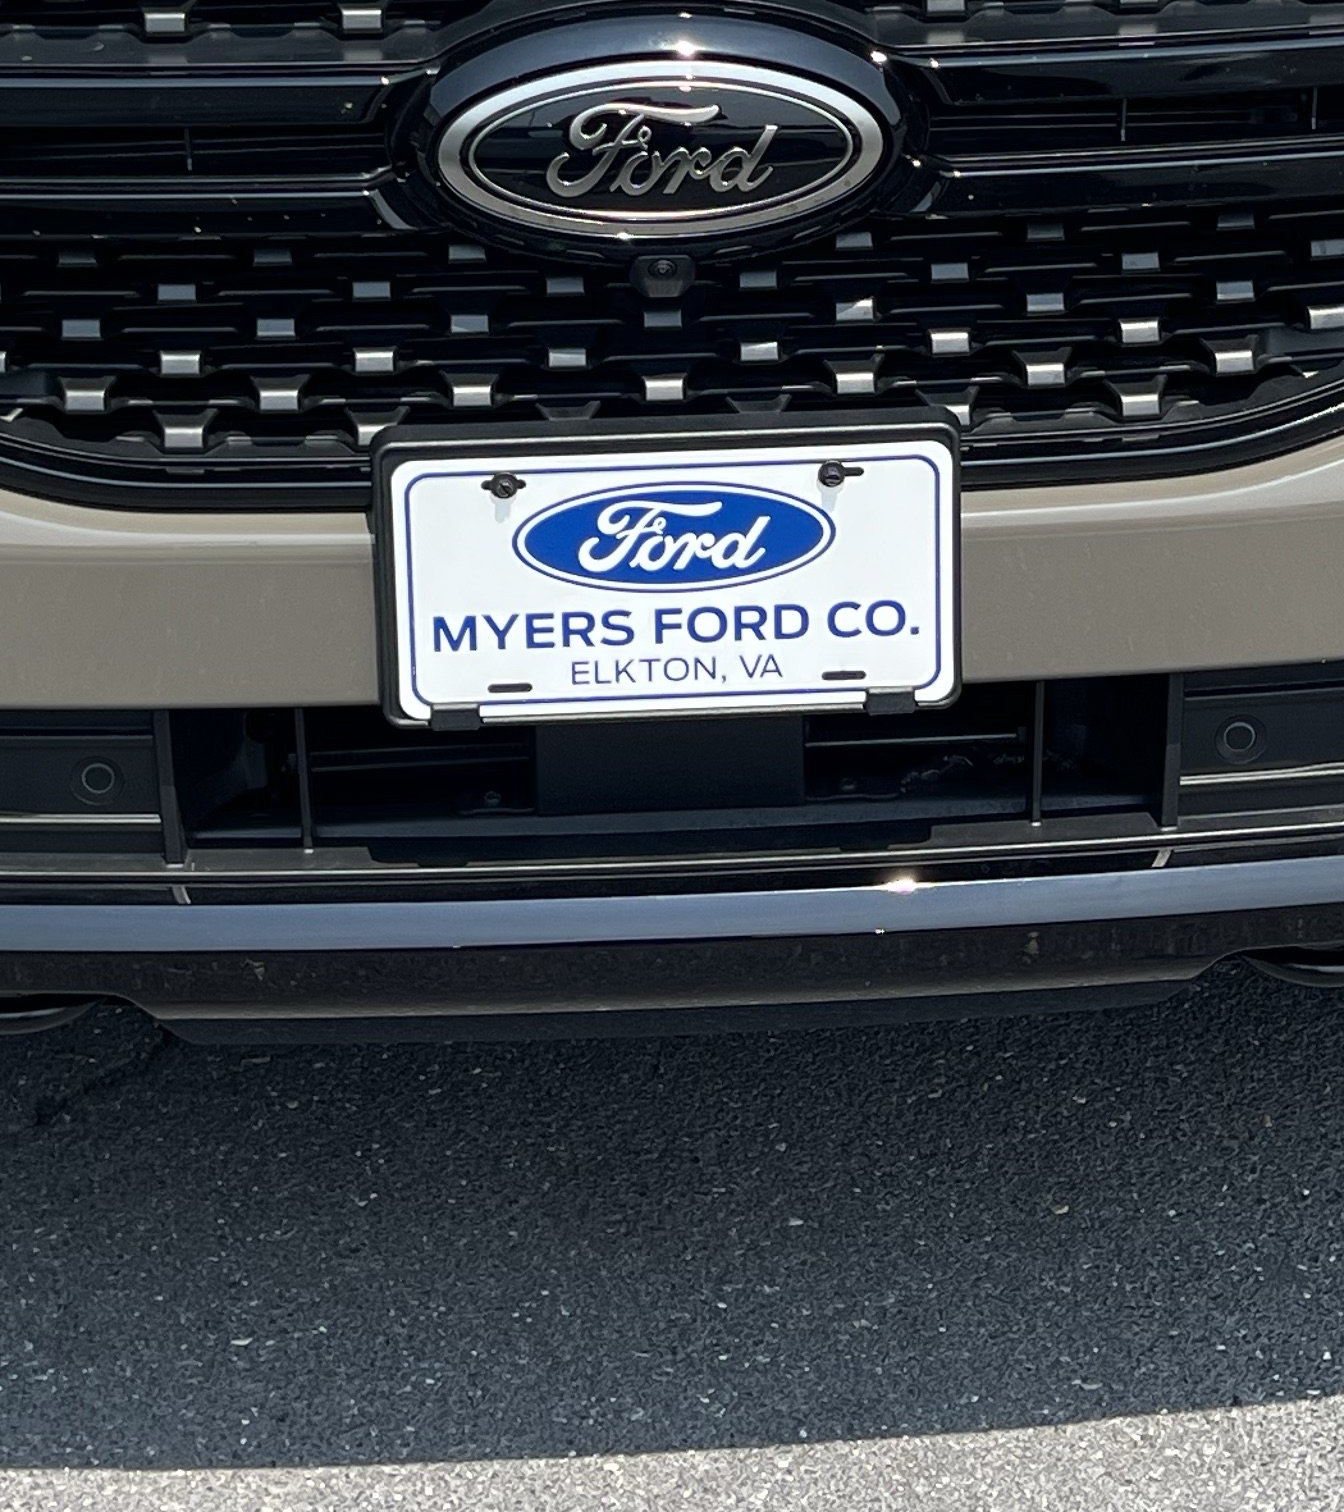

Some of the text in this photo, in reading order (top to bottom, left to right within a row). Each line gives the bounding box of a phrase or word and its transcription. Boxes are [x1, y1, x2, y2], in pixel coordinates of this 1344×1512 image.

[546, 103, 778, 197] Ford
[577, 501, 771, 572] Ford
[433, 599, 921, 652] MYERS FORD CO.
[571, 653, 783, 685] ELKTON, VA
